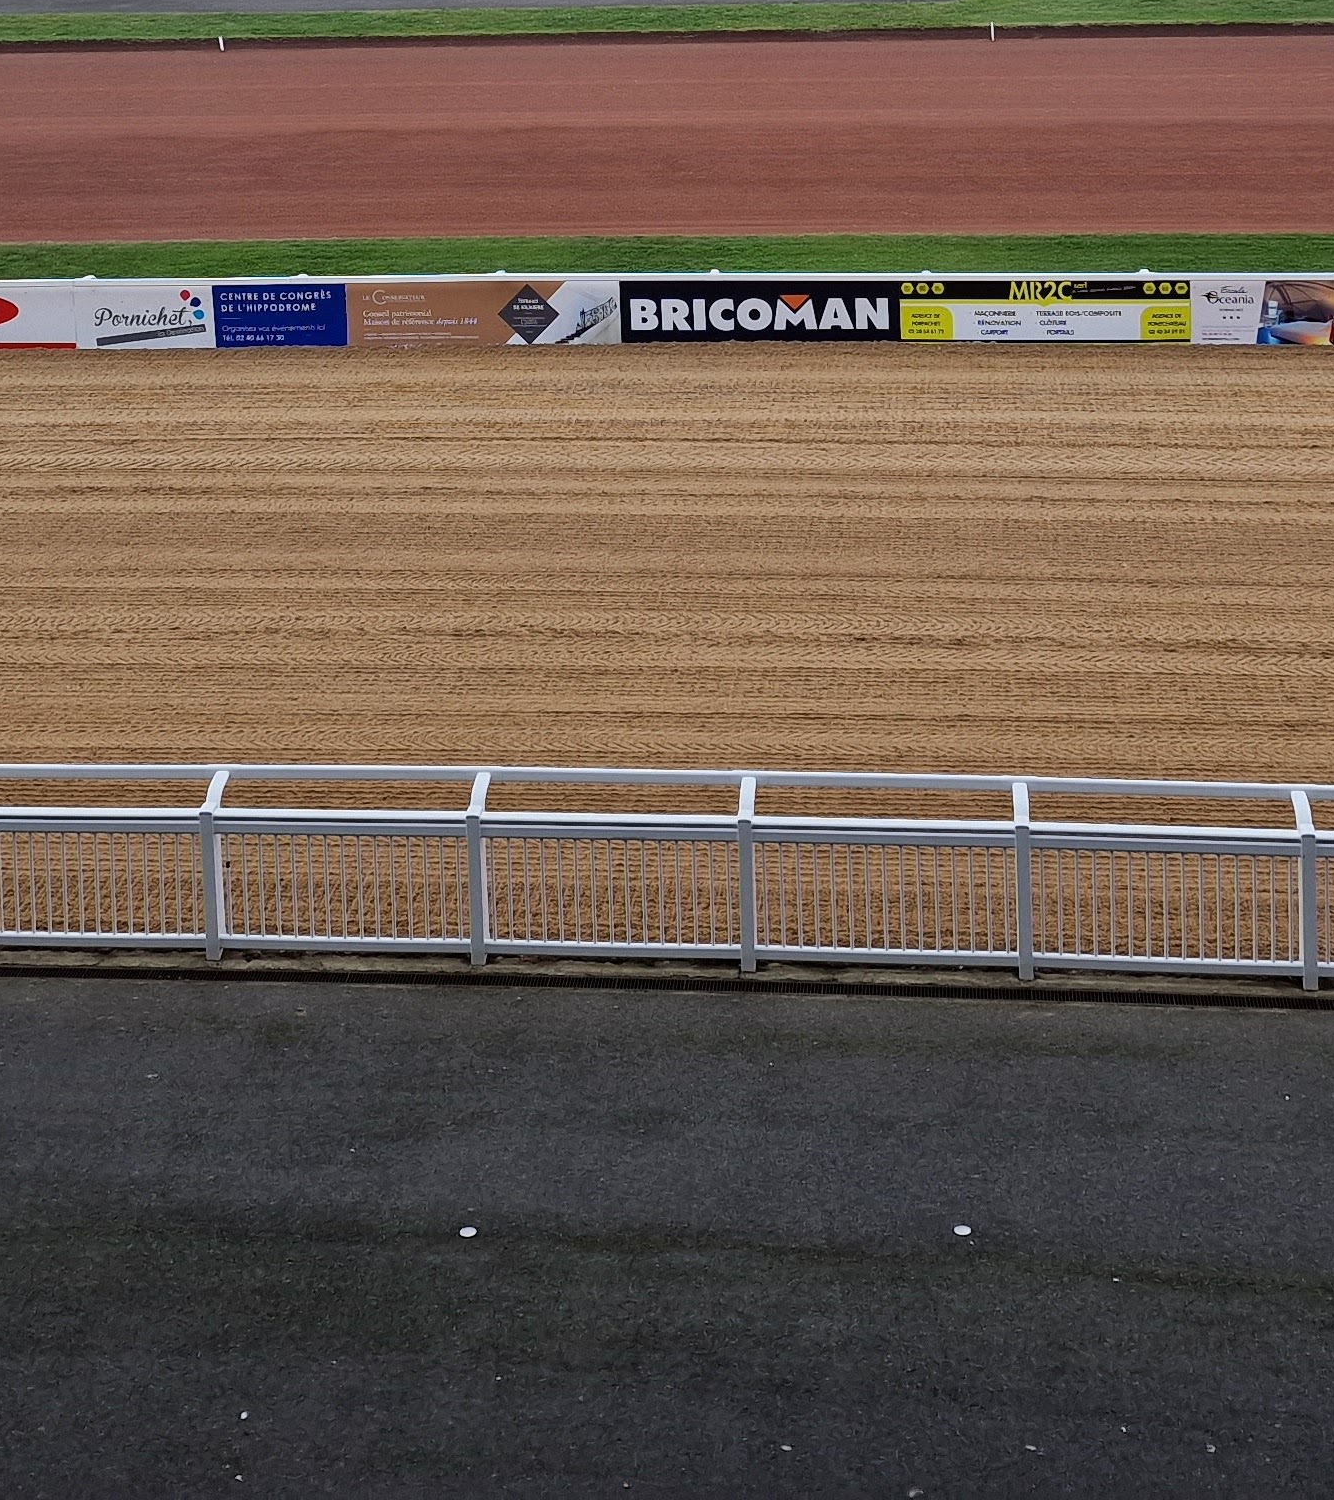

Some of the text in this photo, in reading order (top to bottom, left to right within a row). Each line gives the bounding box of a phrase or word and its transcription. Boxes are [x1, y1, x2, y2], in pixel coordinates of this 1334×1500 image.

[220, 292, 259, 301] CENTRE
[262, 292, 276, 301] DE
[1008, 281, 1073, 300] MR2C
[1206, 290, 1254, 304] Oceania
[221, 303, 316, 312] DE L'HIPPODROME
[630, 297, 890, 331] BRICOMAN
